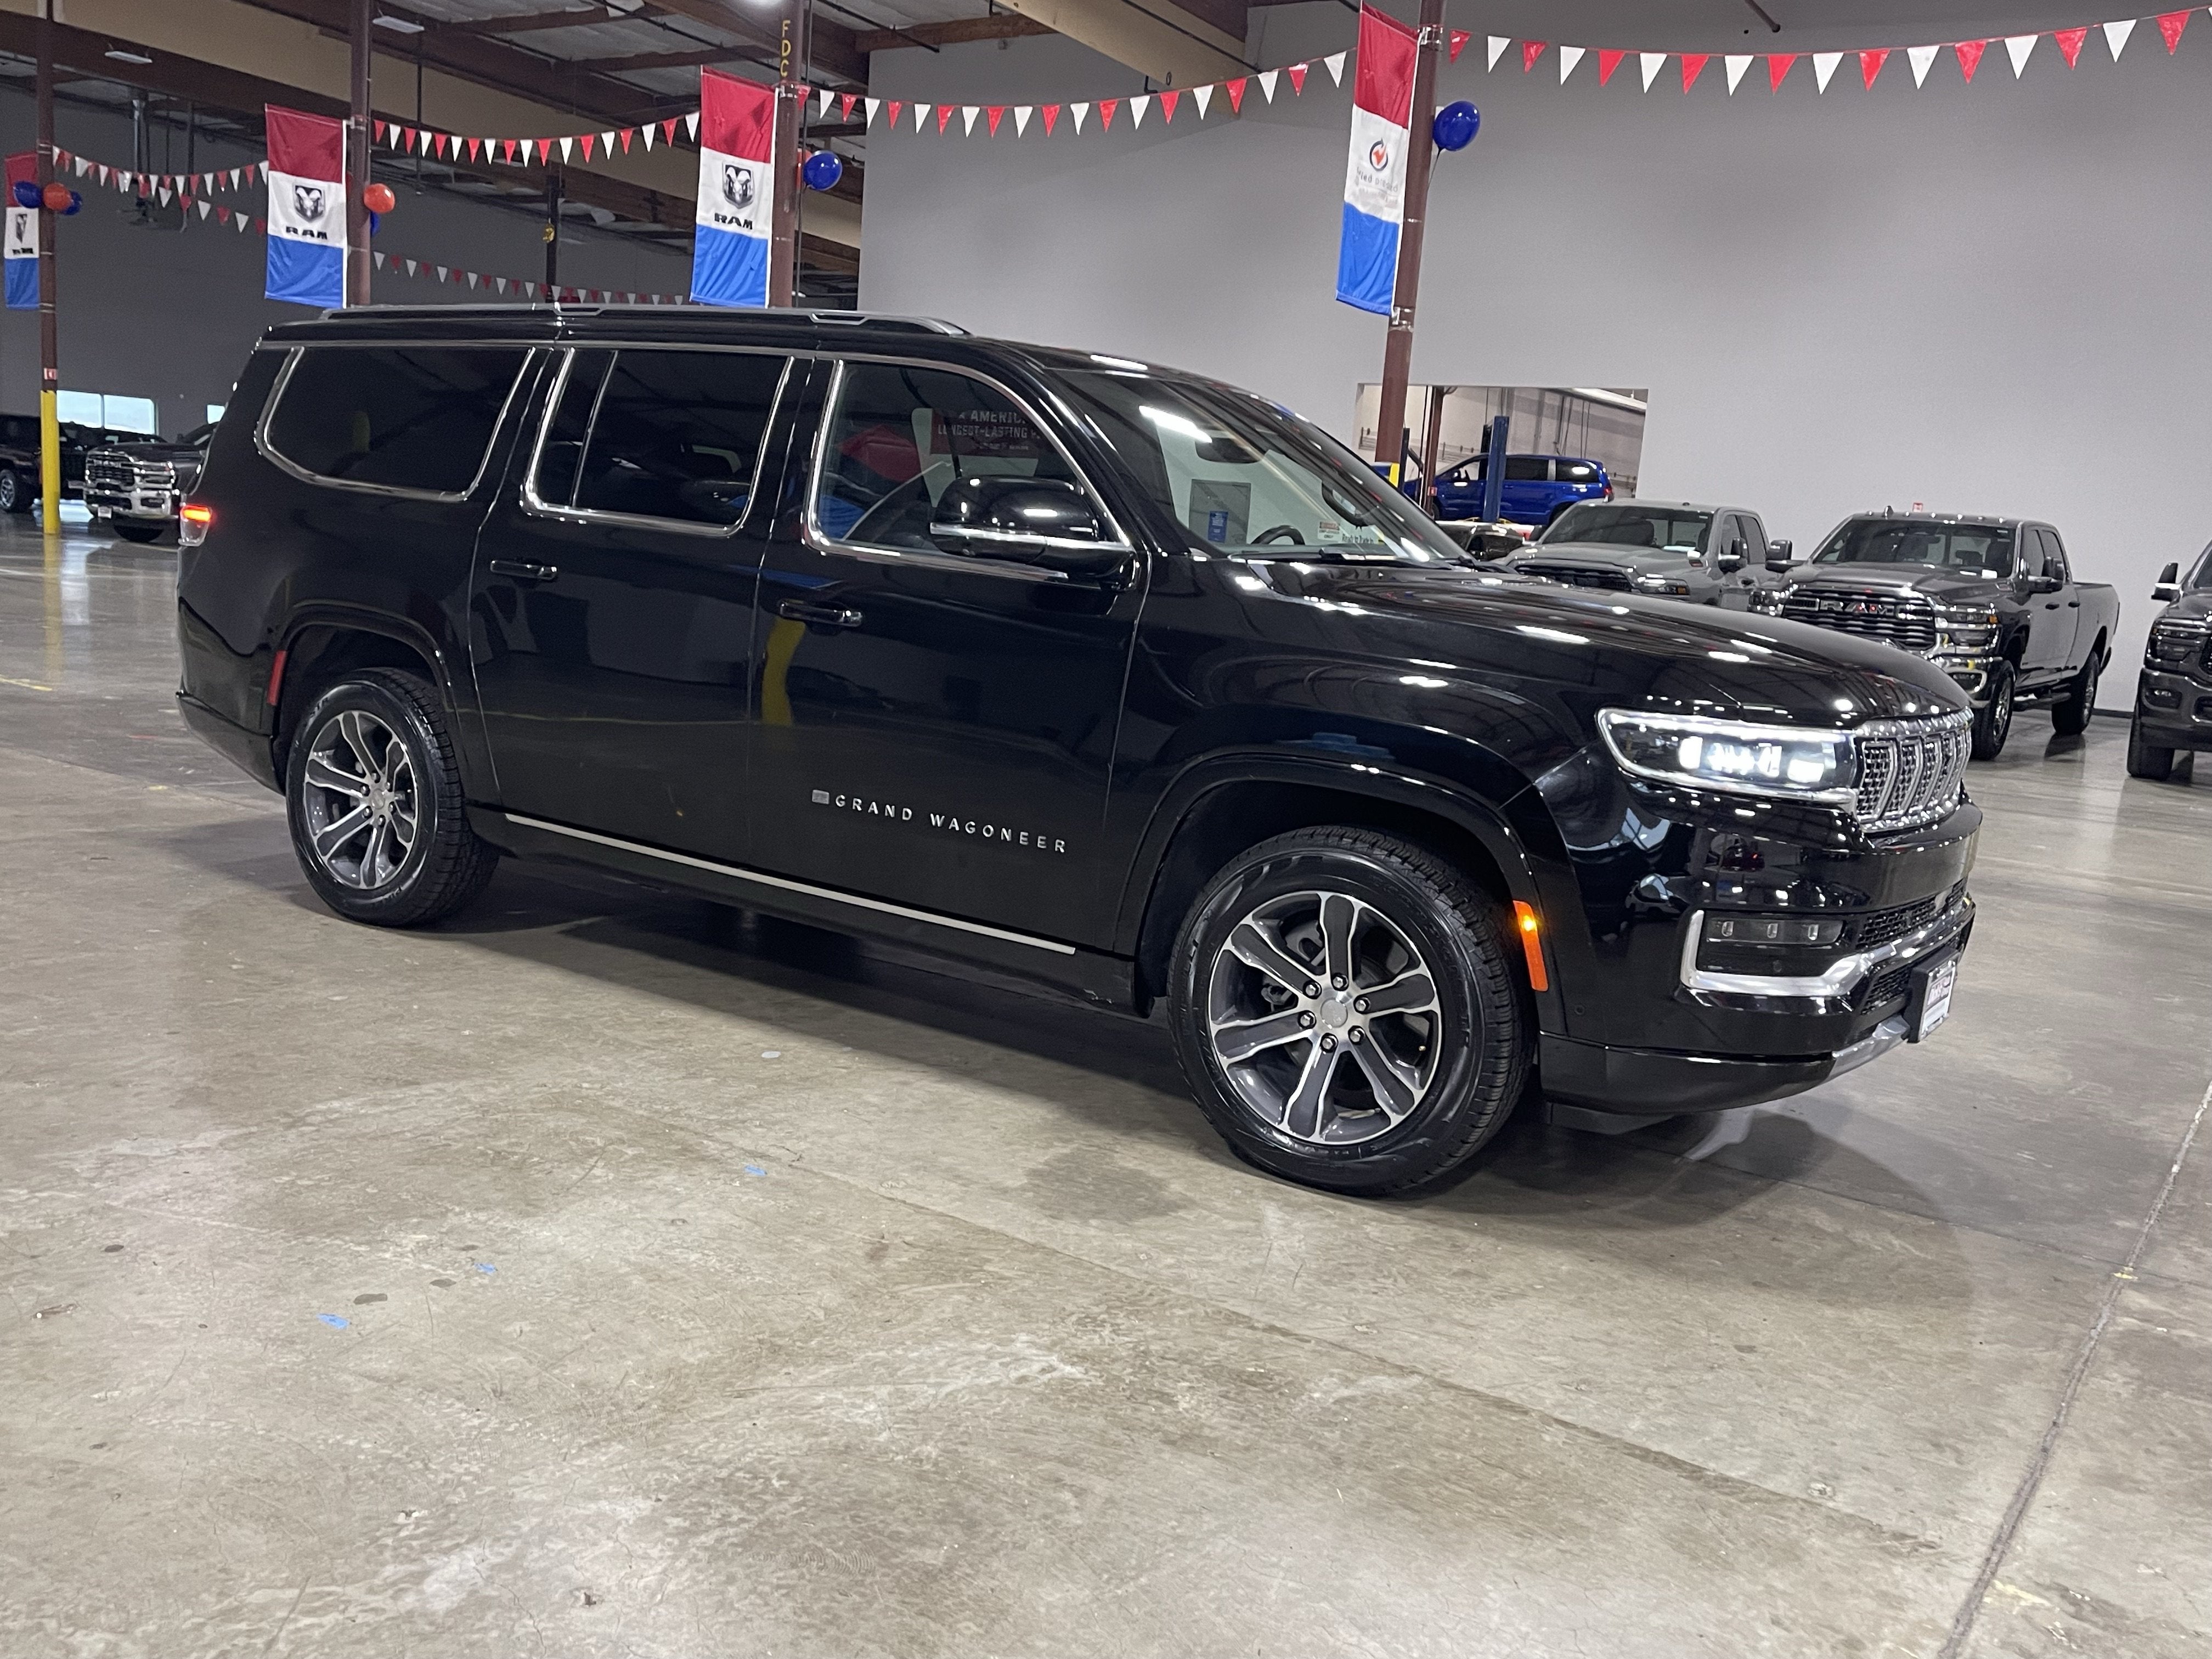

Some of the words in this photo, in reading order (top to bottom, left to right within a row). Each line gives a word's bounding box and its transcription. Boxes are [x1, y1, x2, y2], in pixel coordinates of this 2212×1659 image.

[780, 19, 791, 77] FDC
[714, 212, 753, 230] RAM
[286, 226, 328, 240] RAM
[970, 410, 1026, 424] AMERIC
[1820, 600, 1895, 616] RAM
[835, 794, 912, 821] GRAND
[930, 812, 1066, 853] WAGONEER
